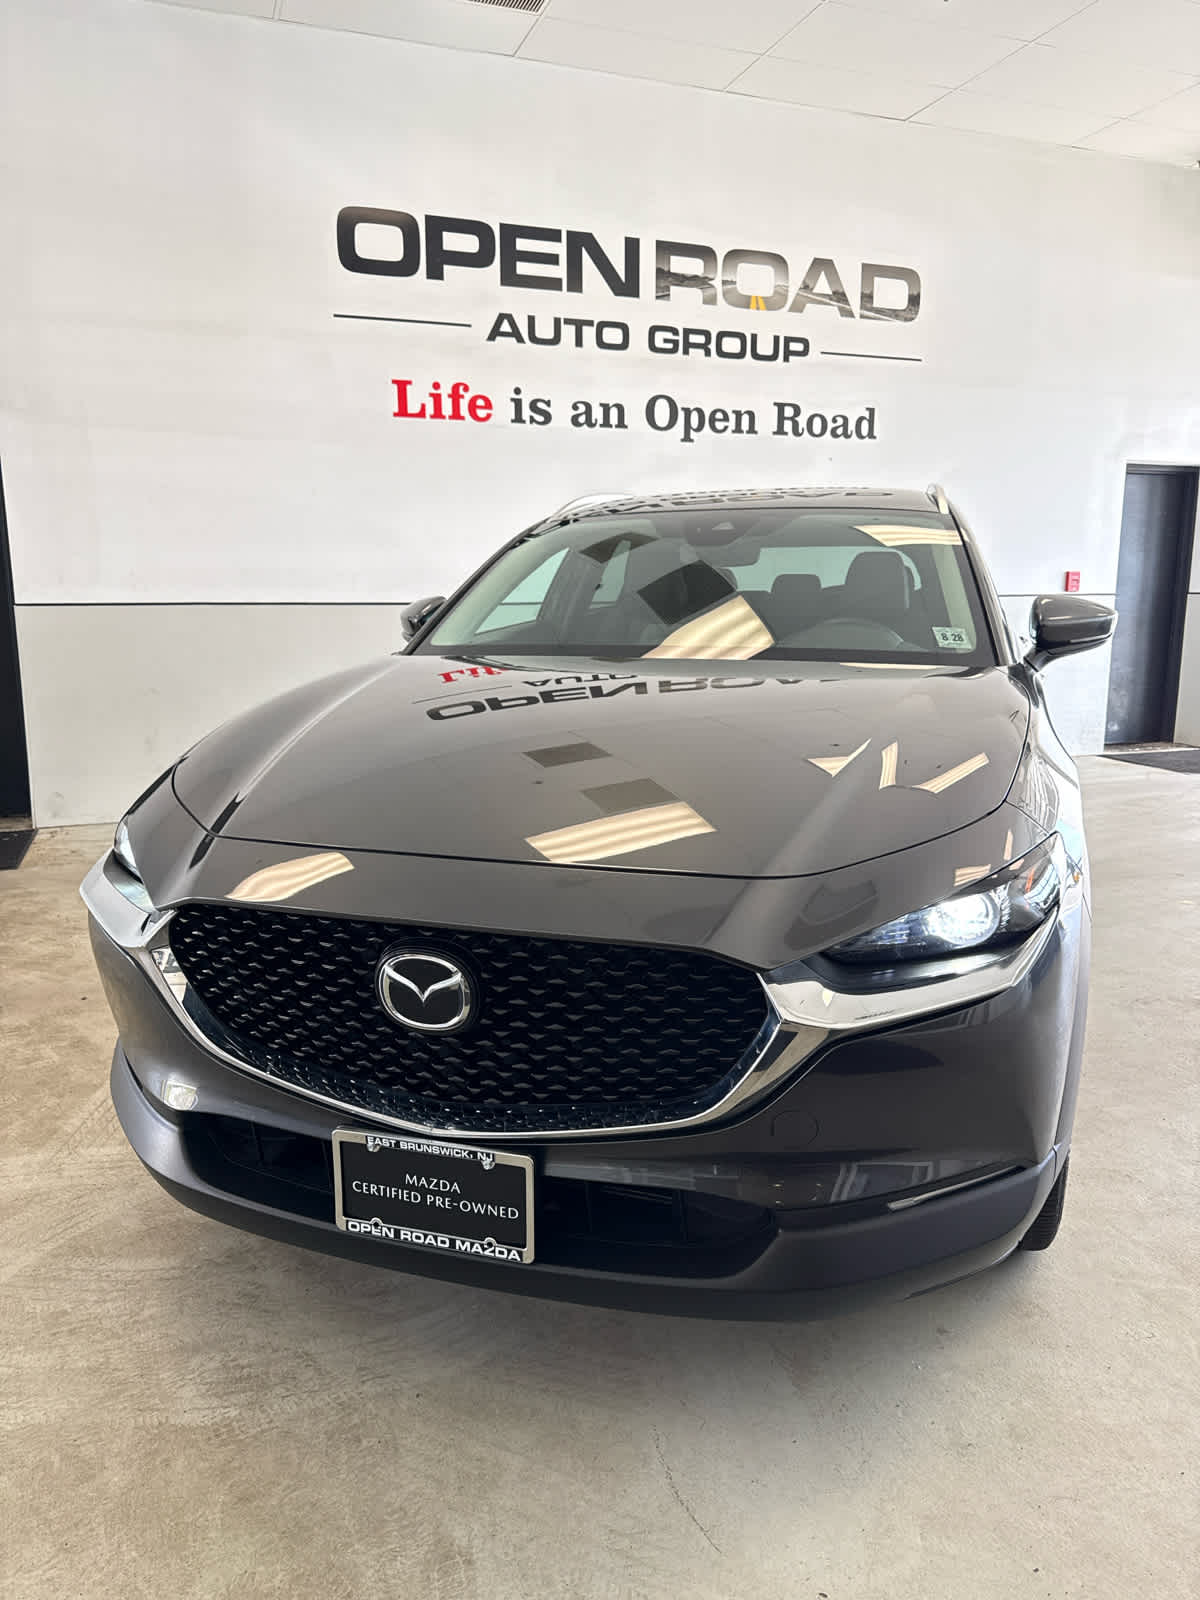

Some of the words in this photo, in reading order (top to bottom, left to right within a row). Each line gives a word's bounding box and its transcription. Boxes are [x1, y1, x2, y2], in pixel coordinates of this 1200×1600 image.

[336, 205, 641, 299] OPEN
[655, 239, 922, 323] ROAD
[486, 312, 631, 351] AUTO
[647, 324, 810, 363] GROUP
[391, 379, 494, 422] Life
[510, 386, 553, 425] is
[570, 402, 628, 430] an
[644, 393, 759, 443] Open
[772, 401, 878, 441] Road
[367, 1136, 397, 1148] EAST
[399, 1141, 474, 1159] BRUNSWICK,
[477, 1152, 494, 1162] NJ
[352, 1180, 421, 1204] CERTIFIED
[426, 1194, 519, 1220] PRE-OWNED
[405, 1173, 461, 1194] MAZDA
[347, 1220, 395, 1239] OPEN
[400, 1230, 450, 1248] ROAD
[455, 1239, 521, 1262] MAZDA
